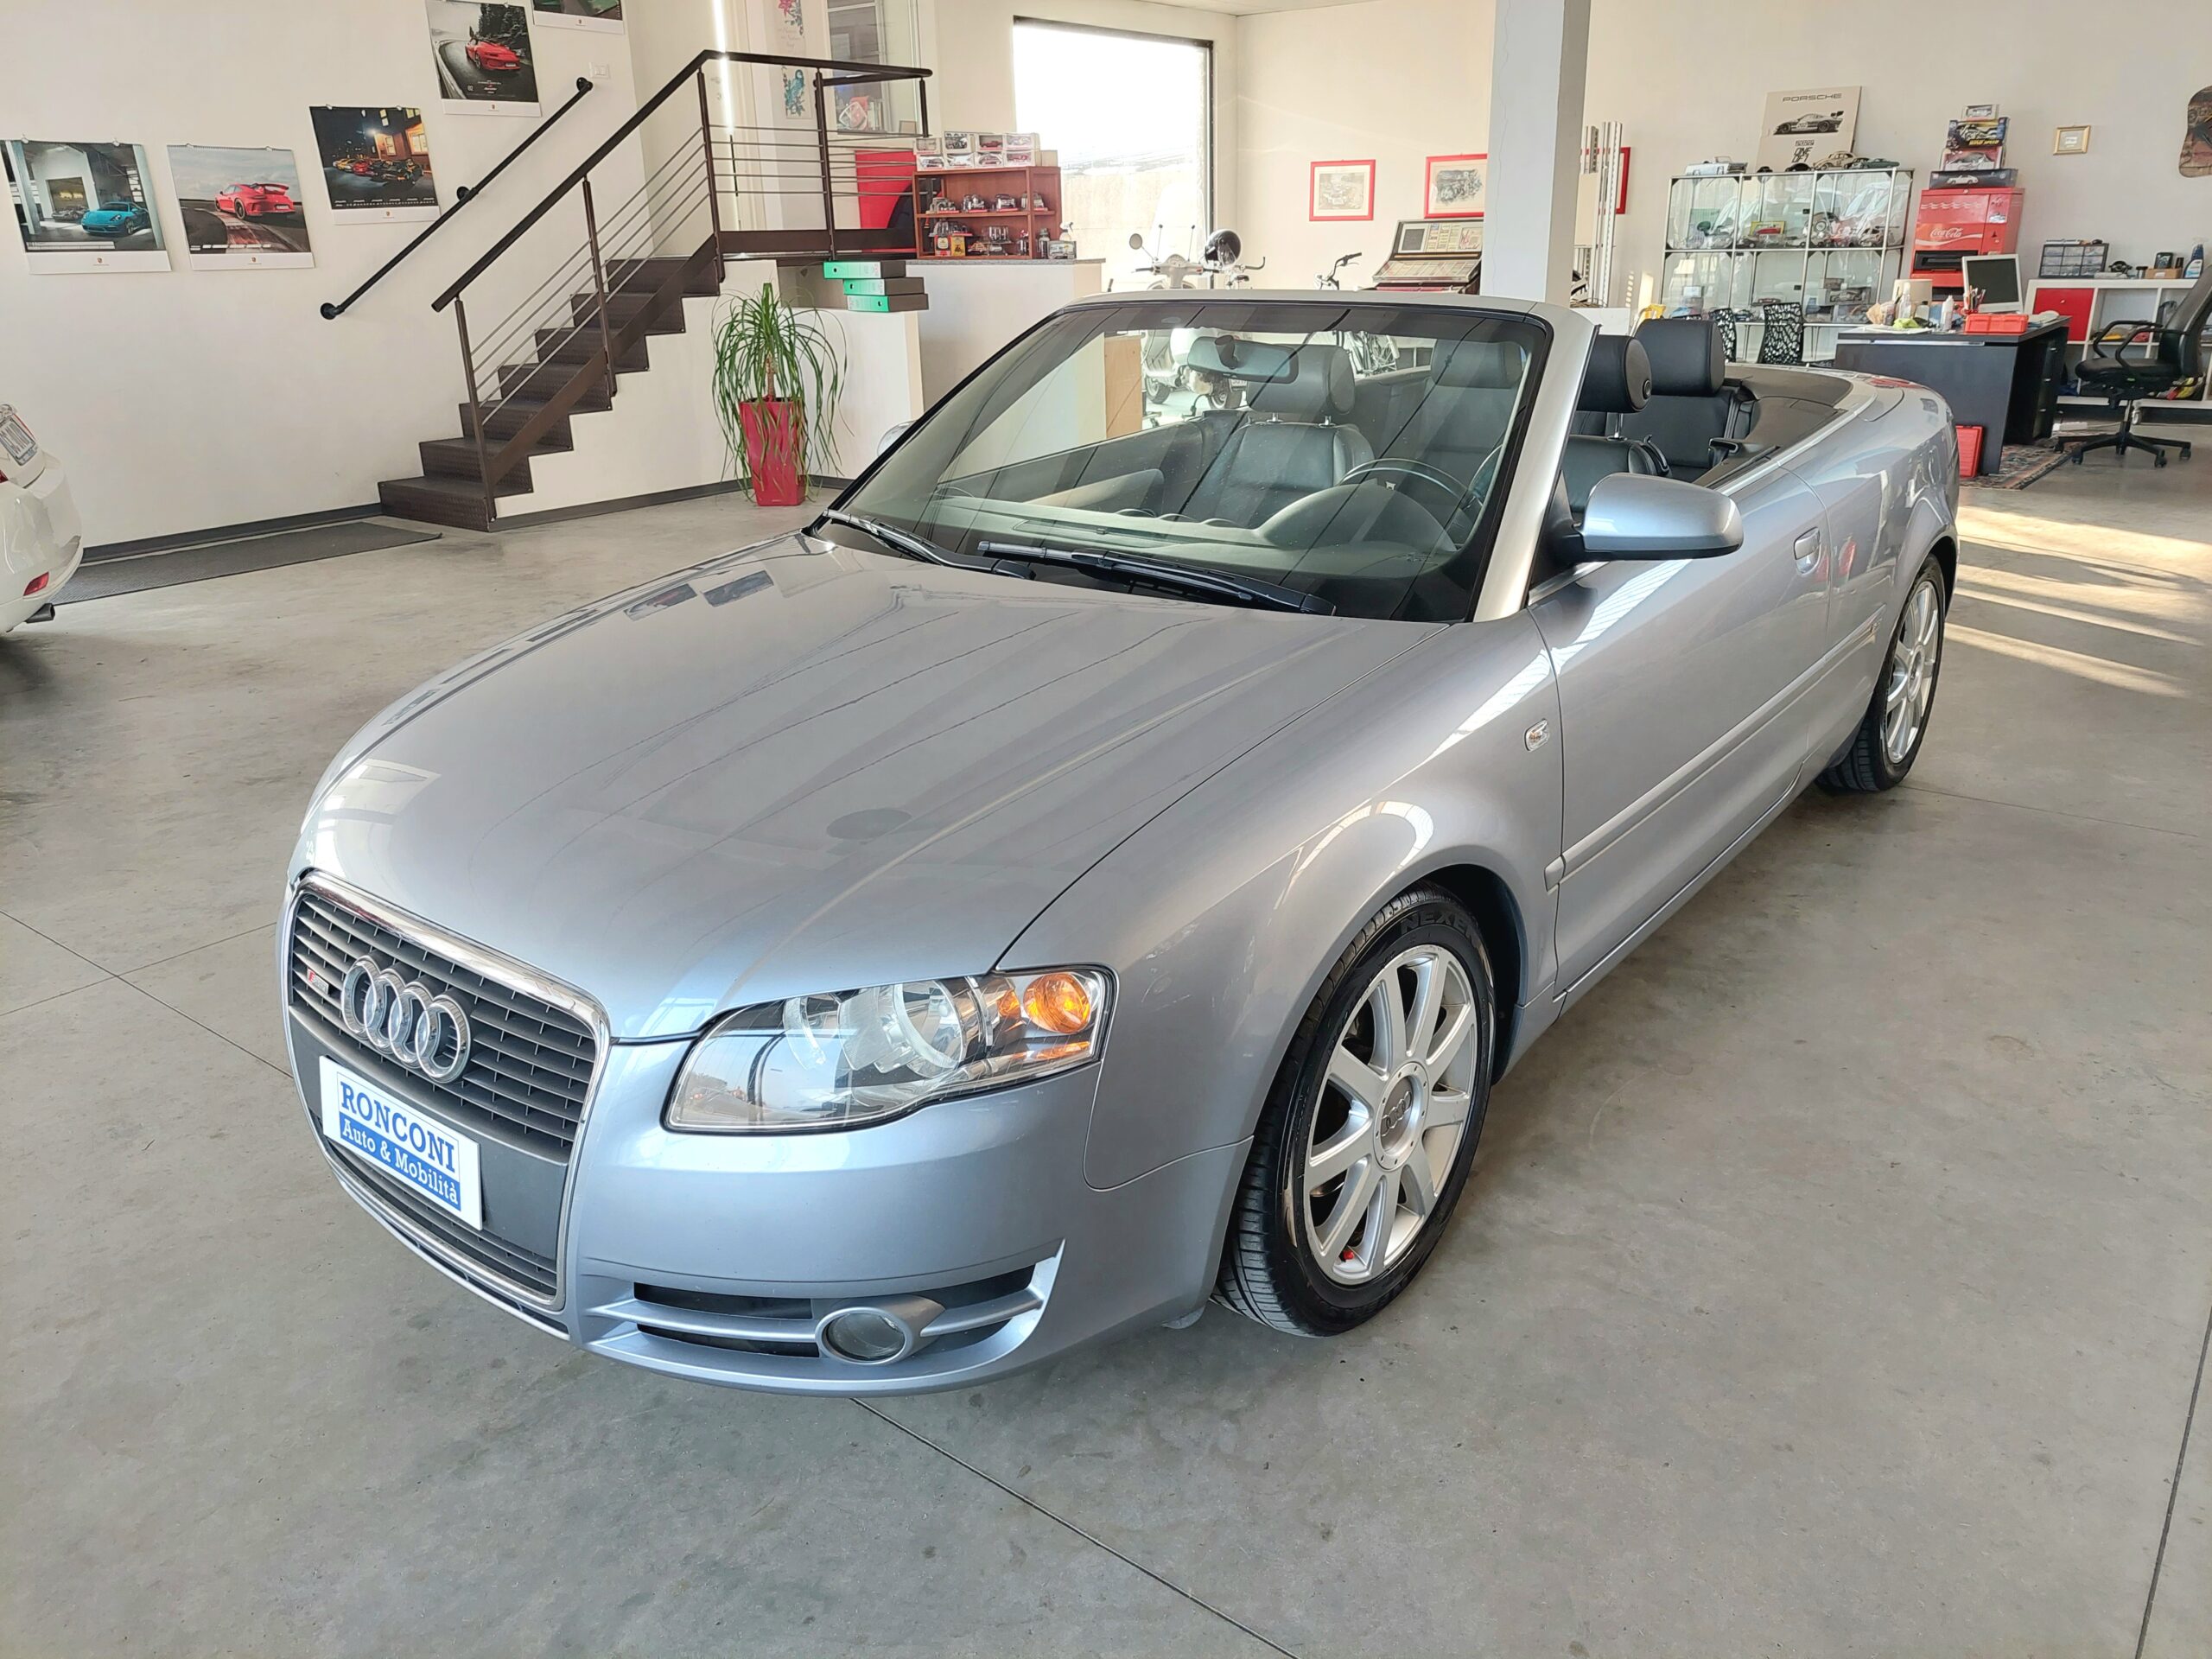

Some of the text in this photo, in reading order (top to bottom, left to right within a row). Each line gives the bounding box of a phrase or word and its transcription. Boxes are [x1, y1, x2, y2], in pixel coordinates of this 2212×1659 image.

[1783, 93, 1841, 103] PORSCHE
[1794, 147, 1812, 156] ONE
[340, 1081, 455, 1173] RONCONI
[343, 1119, 459, 1205] Auto & Mobilità
